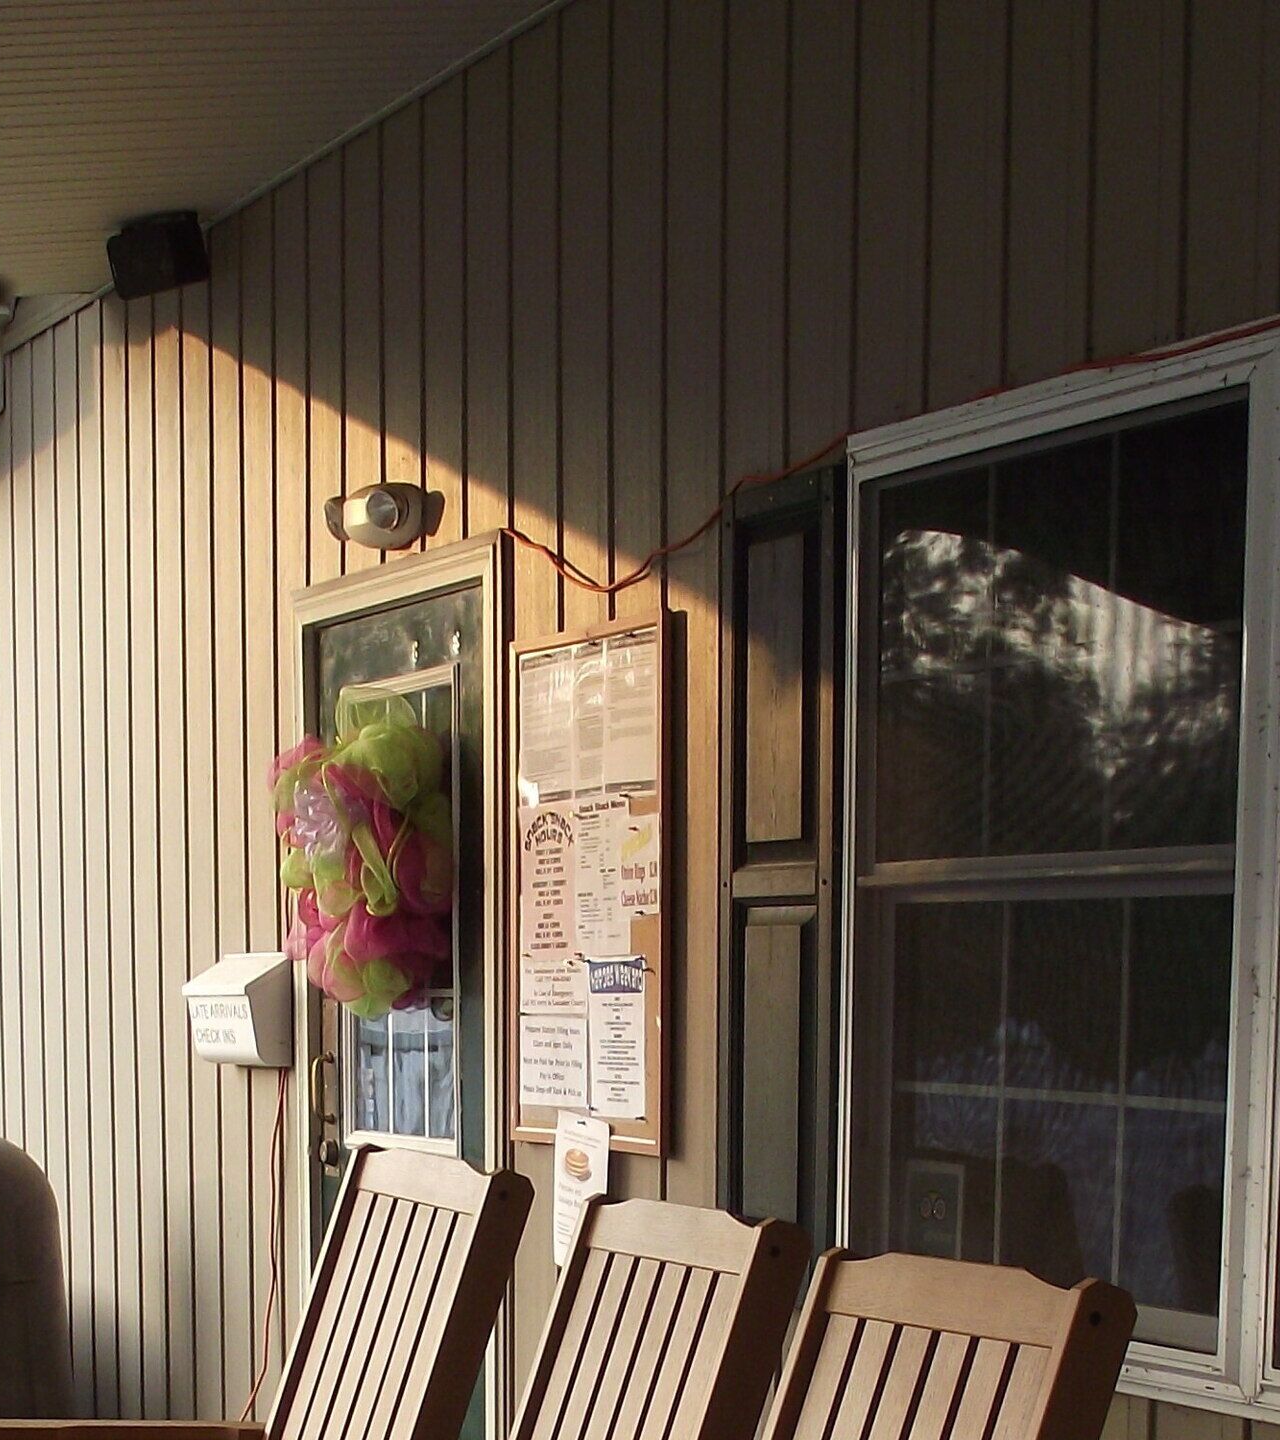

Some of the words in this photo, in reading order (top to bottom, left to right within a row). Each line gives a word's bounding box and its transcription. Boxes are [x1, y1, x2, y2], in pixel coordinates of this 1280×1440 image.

[535, 828, 563, 846] HOURS
[192, 1004, 209, 1019] LATE
[210, 1003, 248, 1019] ARRIVALS
[196, 1028, 221, 1043] CHECK
[222, 1029, 237, 1043] INS
